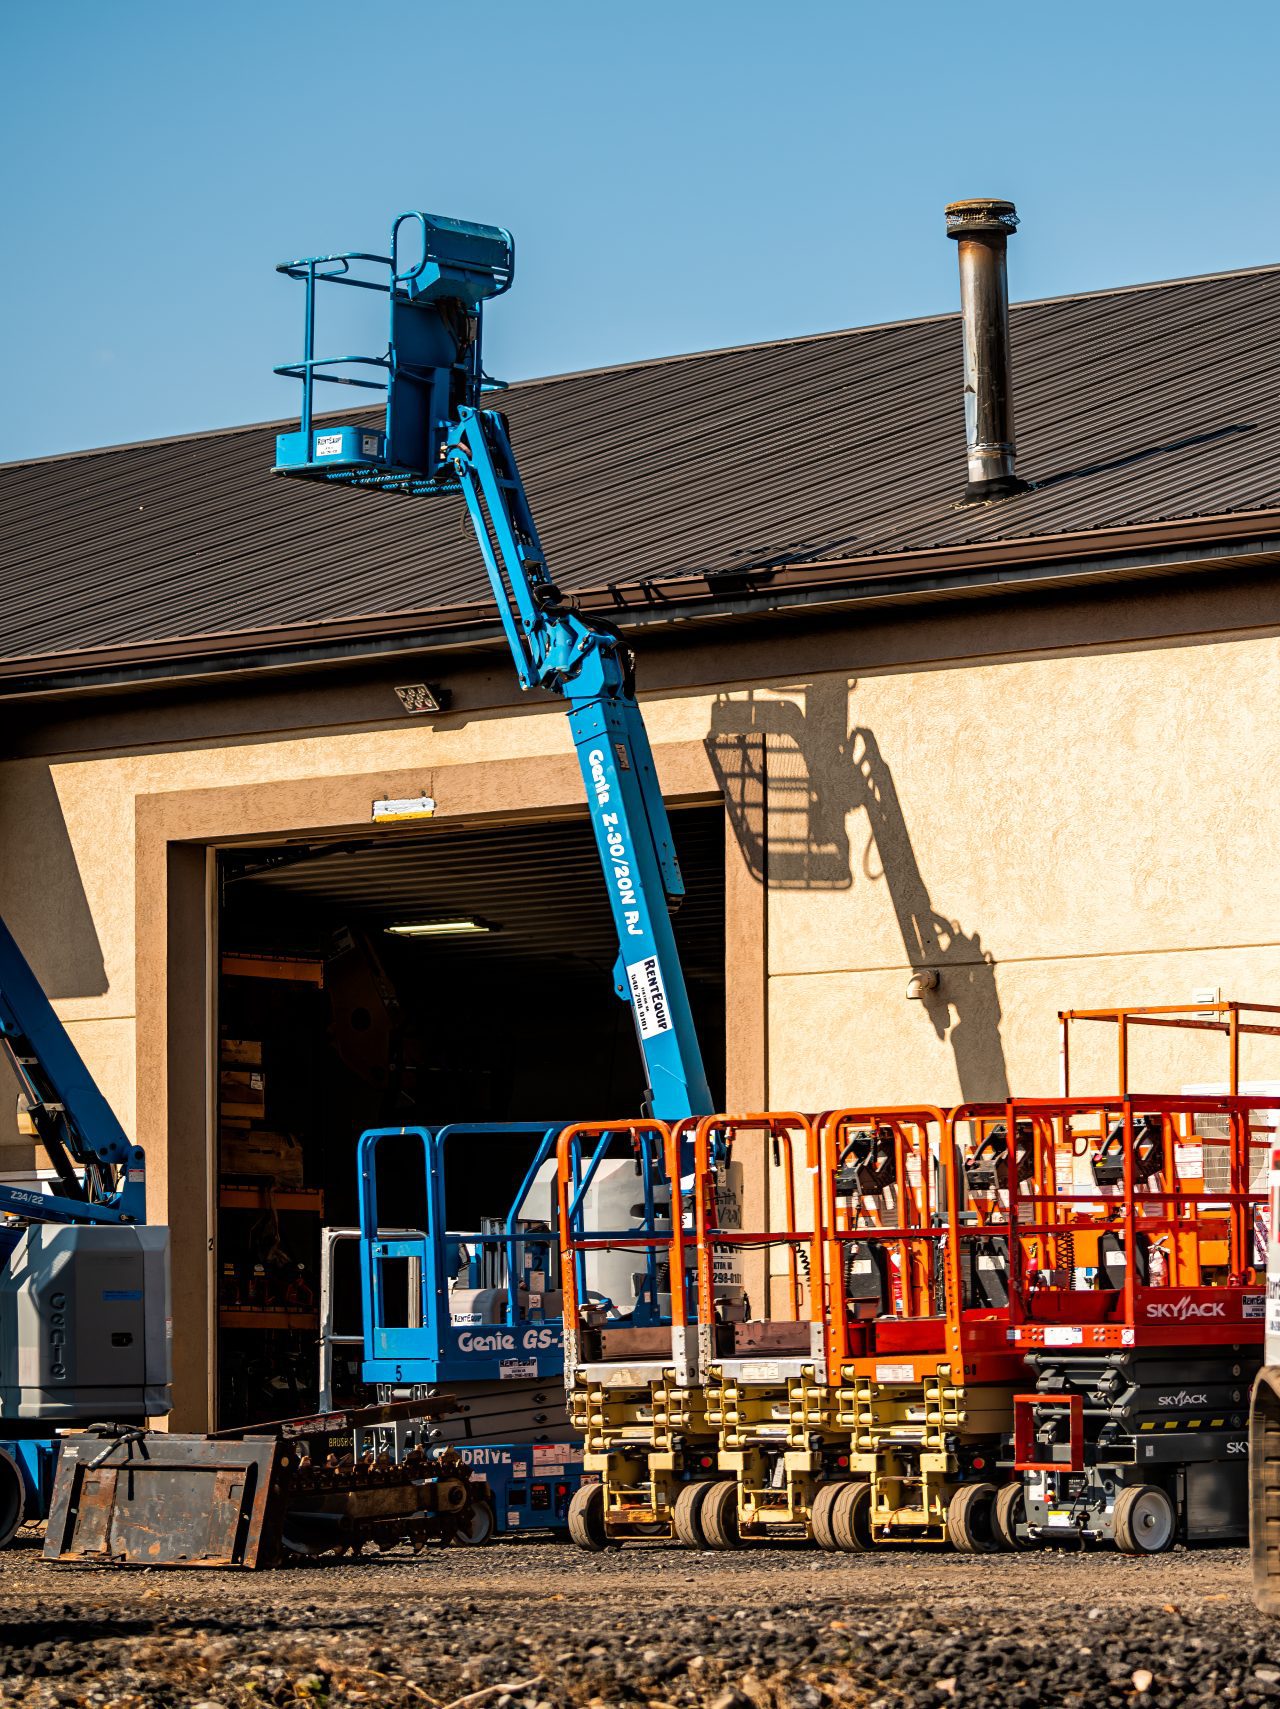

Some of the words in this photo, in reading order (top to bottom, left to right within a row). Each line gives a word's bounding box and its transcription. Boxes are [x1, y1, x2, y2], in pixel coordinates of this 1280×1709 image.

[589, 750, 610, 804] Genie
[602, 813, 636, 905] Z-30/20N
[624, 910, 643, 936] RJ
[10, 1190, 44, 1205] Z34/22
[1146, 1295, 1226, 1320] SKYJACK
[457, 1331, 515, 1352] Genie
[395, 1364, 402, 1381] 5
[1158, 1390, 1208, 1407] SKYJACK
